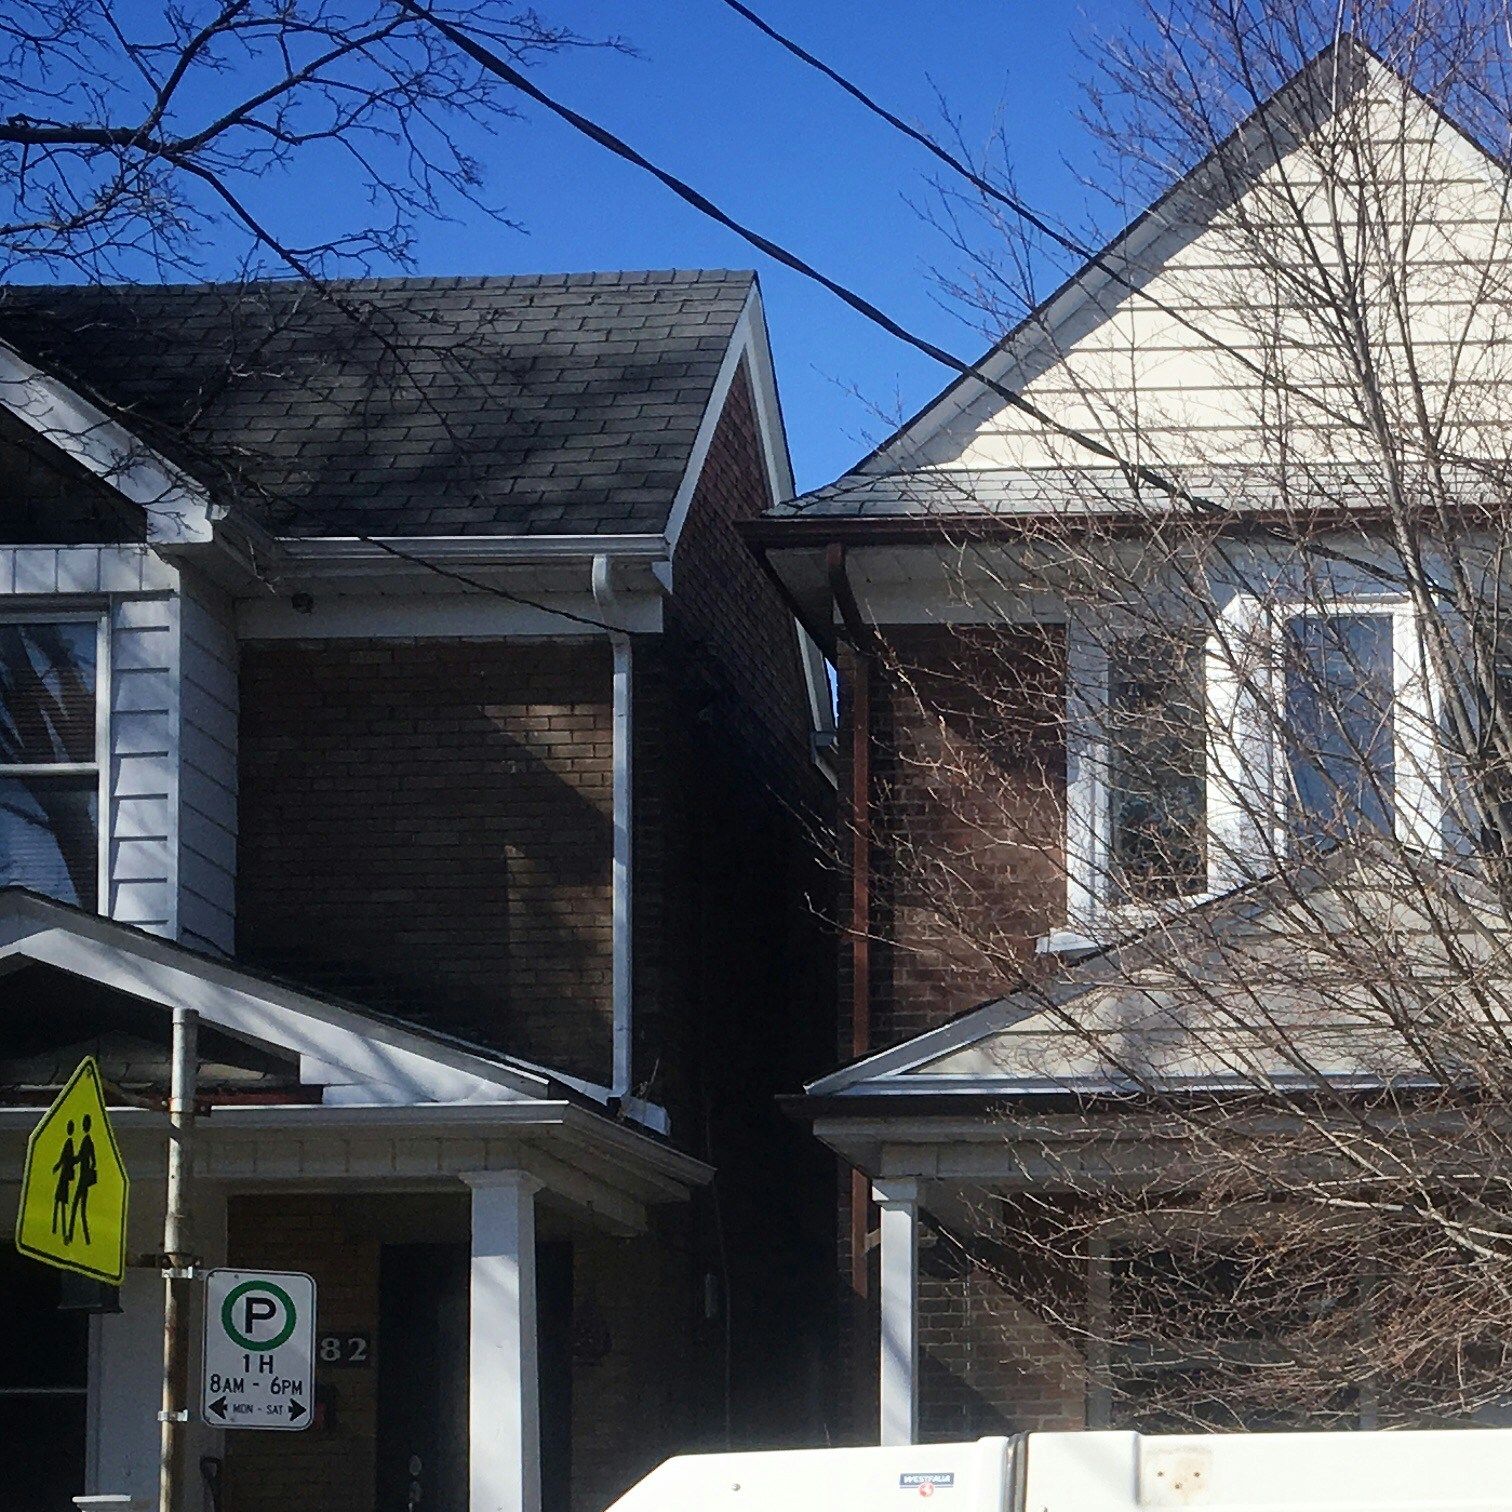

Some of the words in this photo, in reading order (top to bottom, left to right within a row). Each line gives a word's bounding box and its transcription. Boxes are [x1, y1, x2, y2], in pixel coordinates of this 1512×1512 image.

[245, 1297, 277, 1334] P
[243, 1354, 250, 1373] 1
[259, 1355, 274, 1374] H
[210, 1374, 244, 1393] 8AM
[270, 1376, 303, 1395] 6PM
[233, 1404, 253, 1414] MON
[266, 1404, 283, 1415] SAT
